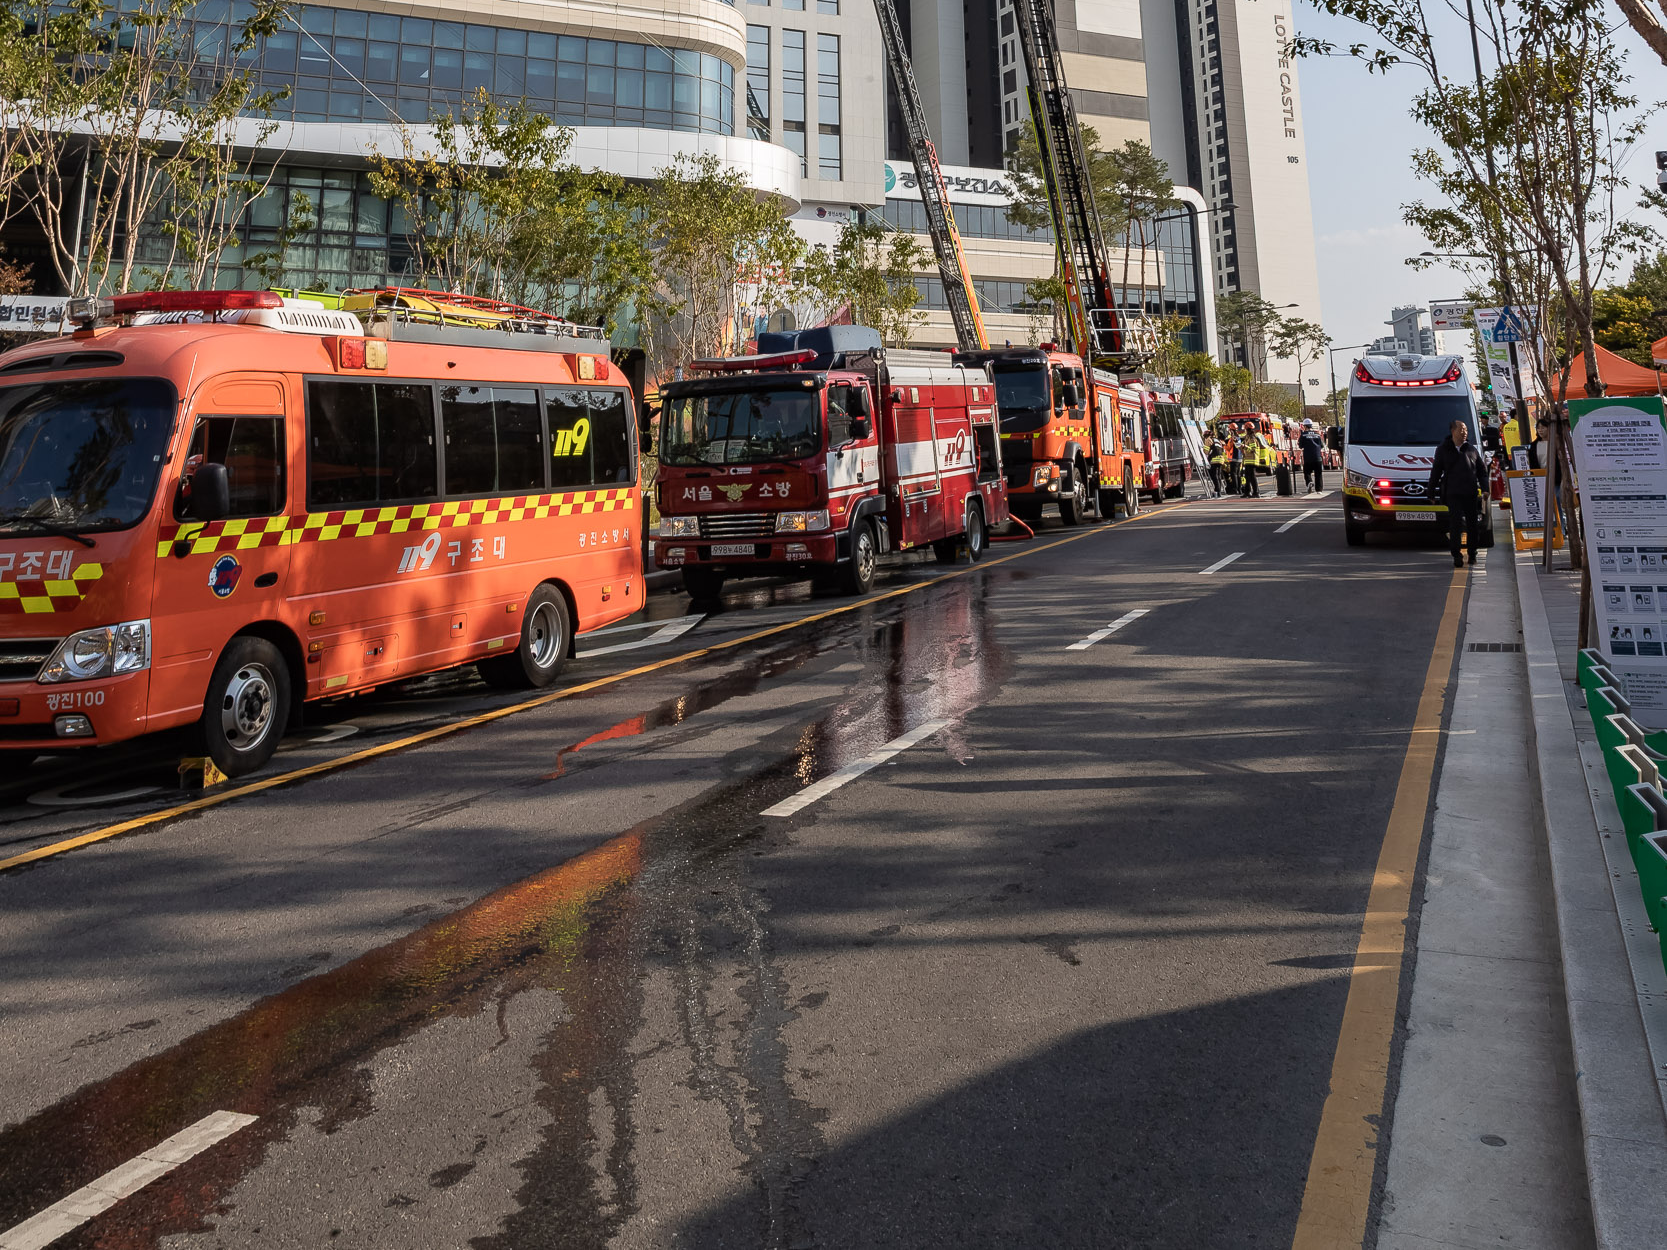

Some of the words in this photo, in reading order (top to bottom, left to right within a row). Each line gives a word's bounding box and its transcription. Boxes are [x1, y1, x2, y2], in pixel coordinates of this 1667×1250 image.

[1279, 72, 1296, 138] CASTLE
[1287, 156, 1299, 164] 105
[899, 172, 1005, 195] 광구보건소
[1308, 378, 1320, 386] 105
[553, 417, 590, 457] 119
[944, 428, 966, 466] 119
[683, 486, 712, 501] 서울
[759, 482, 791, 498] 소방
[579, 527, 629, 547] 광진소방서
[397, 532, 442, 573] 119
[447, 536, 505, 566] 구조대
[47, 691, 104, 710] 광진100
